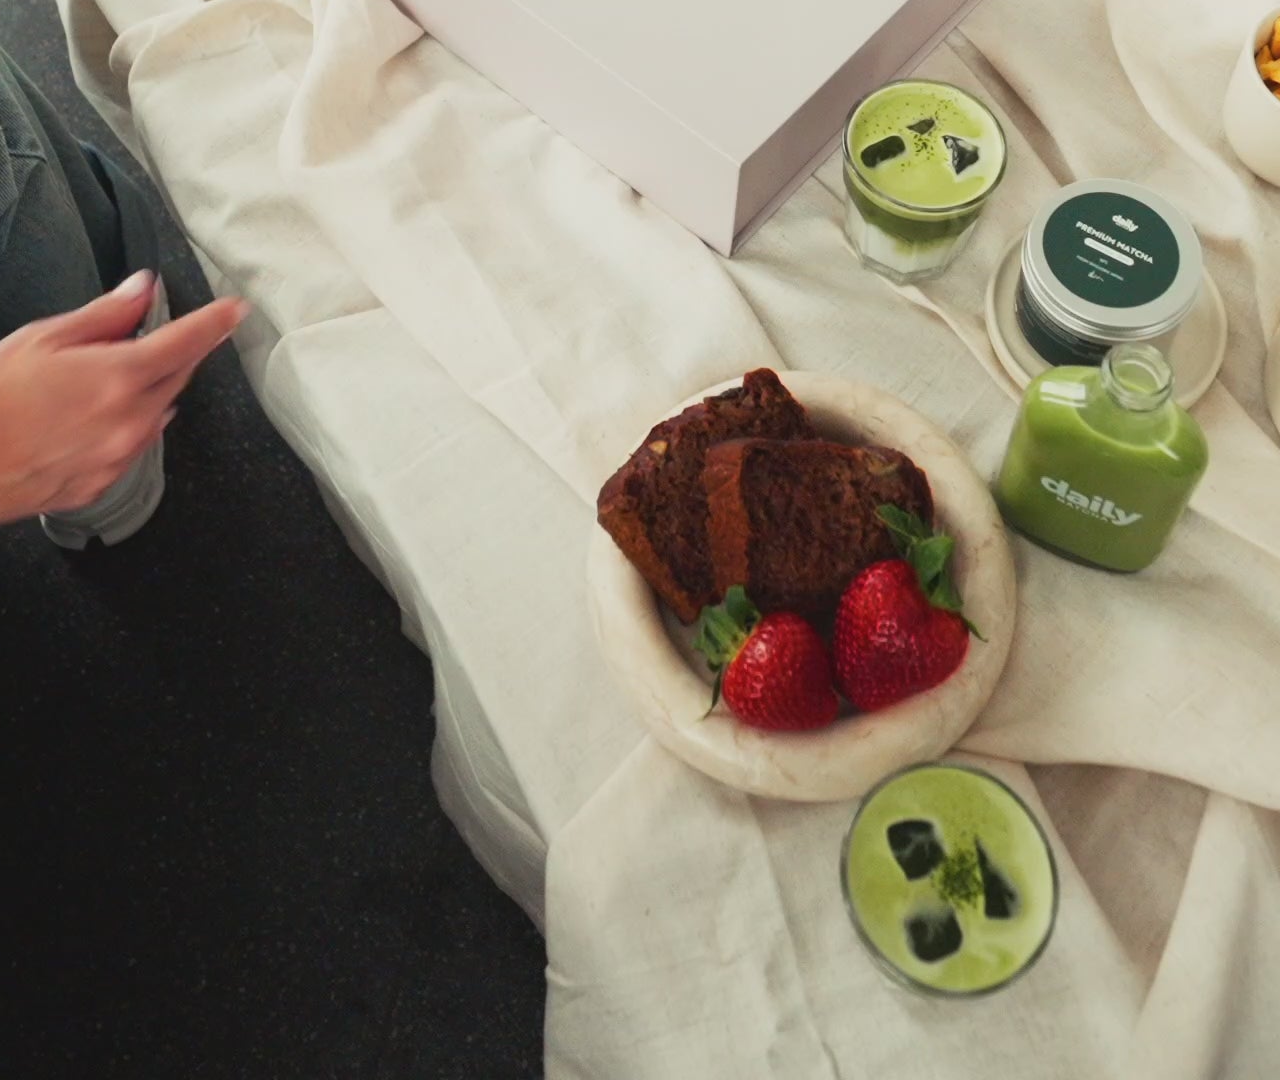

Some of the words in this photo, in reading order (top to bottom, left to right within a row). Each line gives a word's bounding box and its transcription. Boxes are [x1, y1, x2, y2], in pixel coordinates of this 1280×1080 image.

[1075, 221, 1116, 245] PREMIUM
[1117, 241, 1154, 264] MATCHA
[1040, 476, 1143, 526] daily
